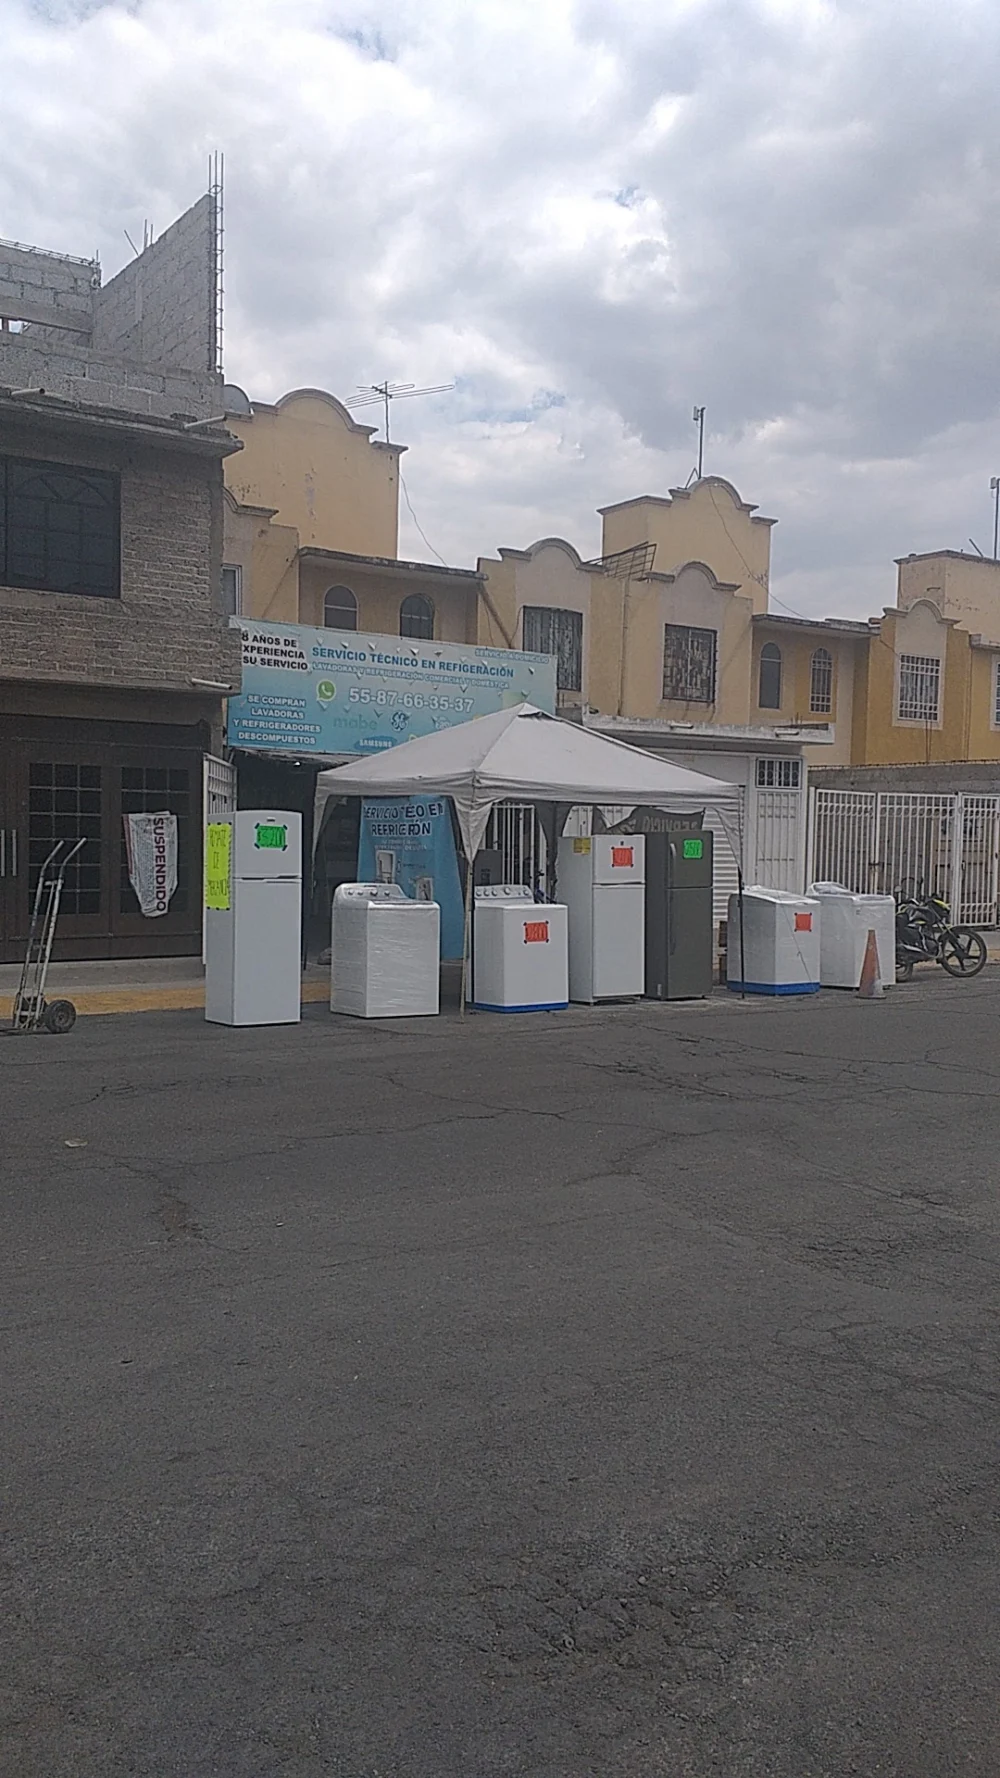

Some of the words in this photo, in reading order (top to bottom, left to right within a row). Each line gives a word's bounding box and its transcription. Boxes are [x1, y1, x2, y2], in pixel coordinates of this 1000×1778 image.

[252, 634, 281, 646] AÑOS
[284, 639, 298, 648] DE
[242, 644, 306, 659] XPERIENCIA
[475, 648, 507, 659] SERVICIO
[243, 655, 257, 665] SU
[260, 657, 308, 670] SERVICIO
[312, 647, 366, 661] SERVICIO
[370, 653, 418, 667] TÉCNICO
[422, 659, 436, 669] EN
[439, 661, 514, 677] REFIGERACIÓN
[313, 662, 358, 673] LAVADORAS
[424, 673, 463, 684] COMERCIAL
[247, 695, 260, 704] SE
[262, 696, 306, 707] COMPRAN
[349, 687, 474, 712] 55-87-66-35-37
[251, 708, 304, 719] LAVADORAS
[242, 720, 321, 732] REFRIGERADORES
[333, 713, 378, 730] mabe
[238, 731, 316, 744] DESCOMPUESTOS
[359, 739, 393, 747] SAMSUNG
[153, 817, 167, 912] SUSPENDIDO
